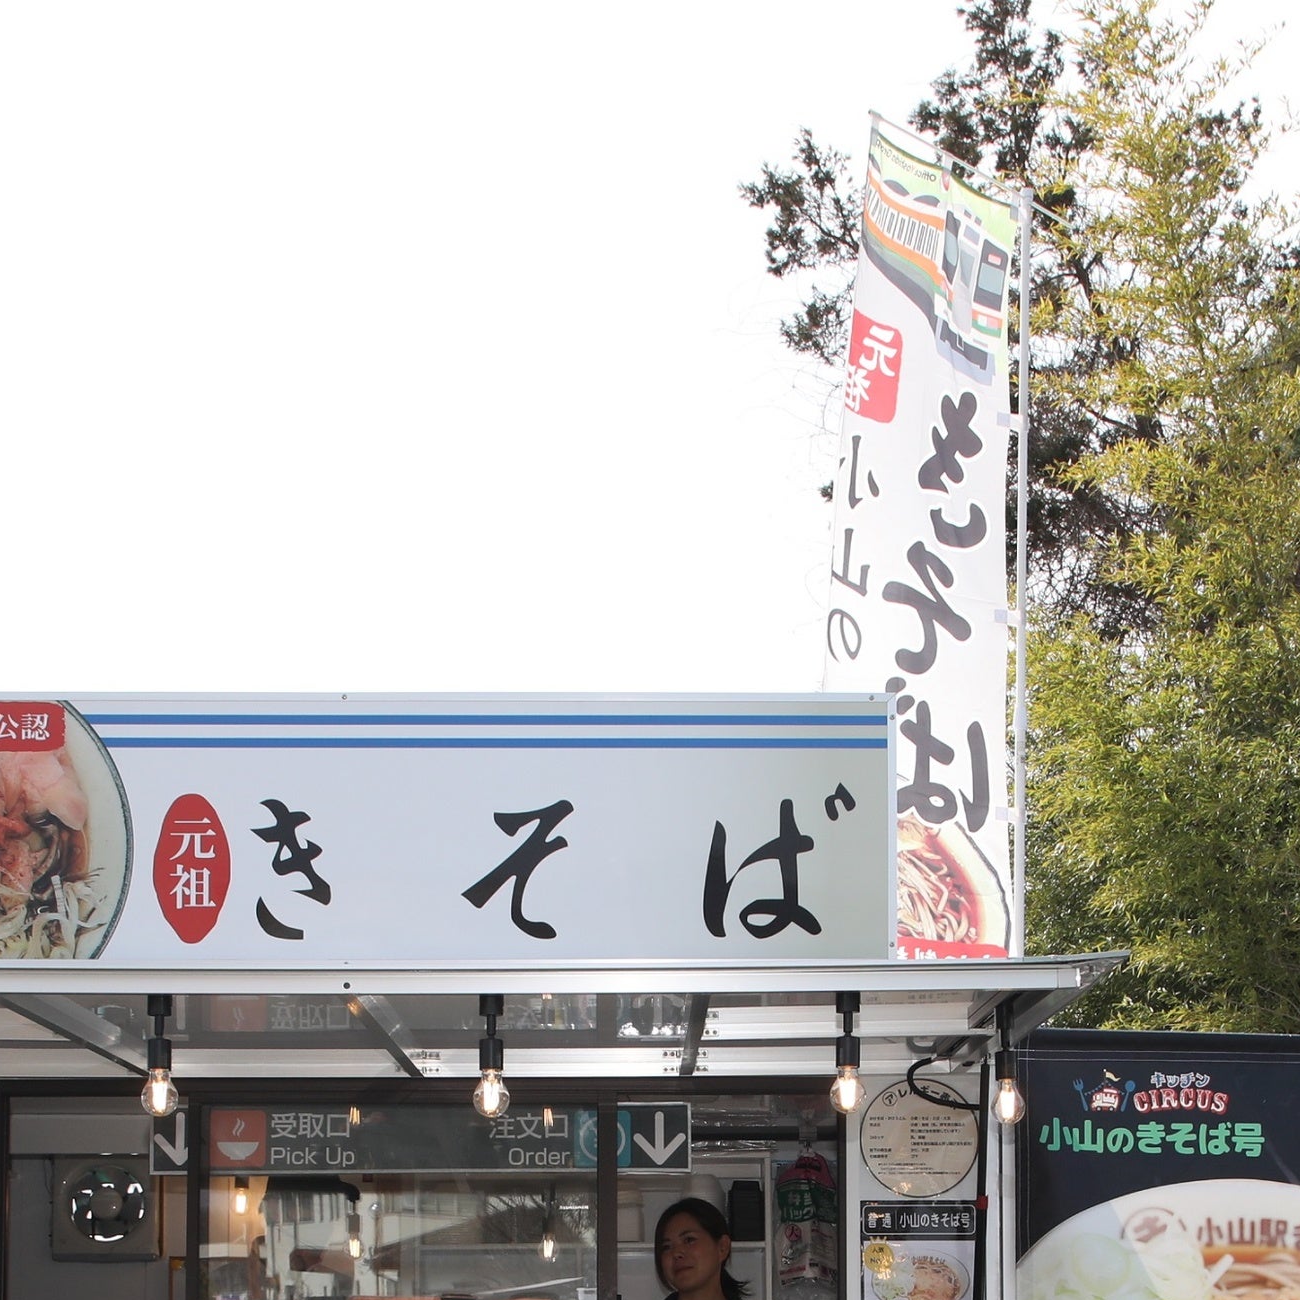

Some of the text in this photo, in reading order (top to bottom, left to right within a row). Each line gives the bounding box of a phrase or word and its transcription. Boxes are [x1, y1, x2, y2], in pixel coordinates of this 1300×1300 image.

[169, 815, 217, 910] 元祖
[251, 782, 856, 940] きそば
[1151, 1072, 1210, 1088] キッチン
[1133, 1088, 1230, 1115] CIRCUS
[270, 1112, 351, 1139] 受取口
[489, 1113, 569, 1141] 注文口
[1039, 1117, 1265, 1157] 小山のきそば号
[270, 1147, 355, 1169] Pick Up
[508, 1147, 571, 1167] Order
[900, 1213, 970, 1228] 小山のきそば号
